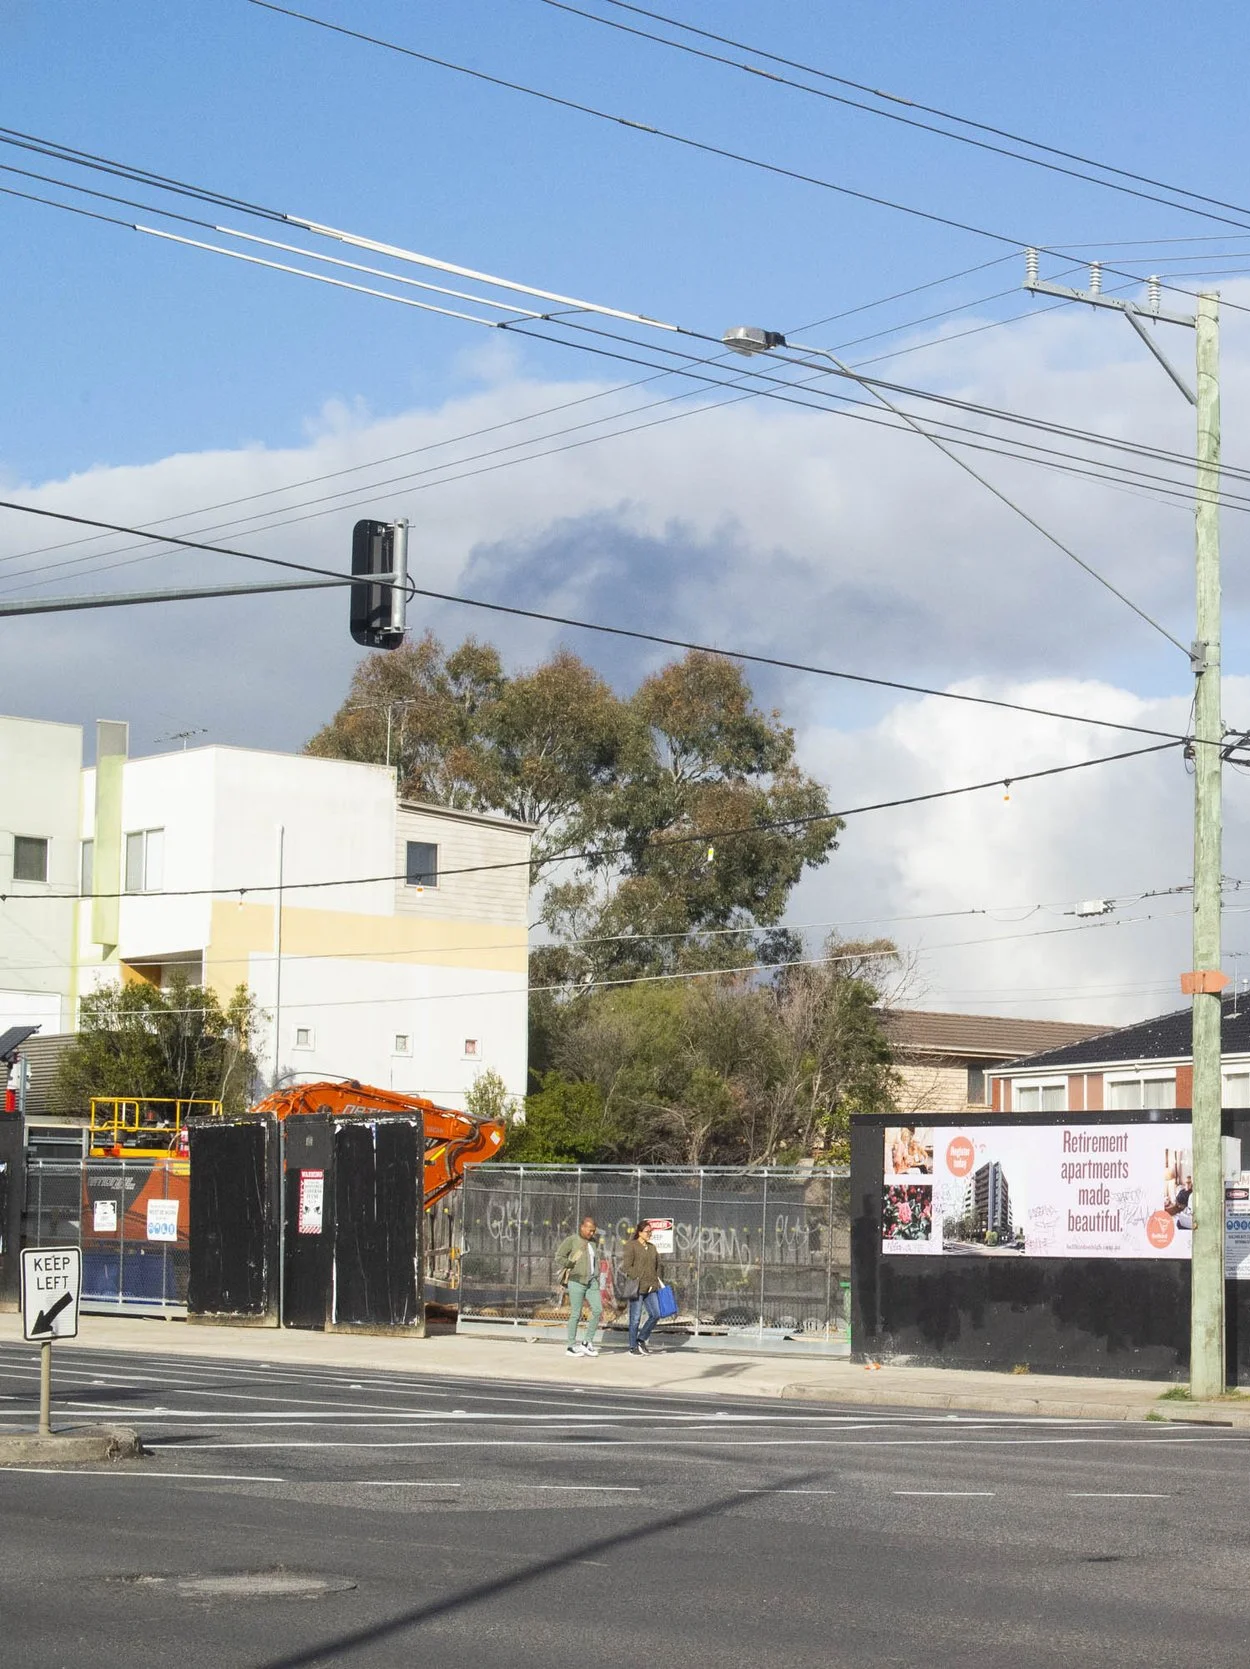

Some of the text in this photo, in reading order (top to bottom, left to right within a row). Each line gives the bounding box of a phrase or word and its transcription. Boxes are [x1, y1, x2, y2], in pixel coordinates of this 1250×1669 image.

[1063, 1130, 1128, 1153] Retirement
[1061, 1159, 1129, 1184] apartments
[1078, 1182, 1110, 1205] made
[1068, 1209, 1123, 1232] beautiful.
[33, 1257, 70, 1271] KEEP
[37, 1276, 69, 1290] LEFT
